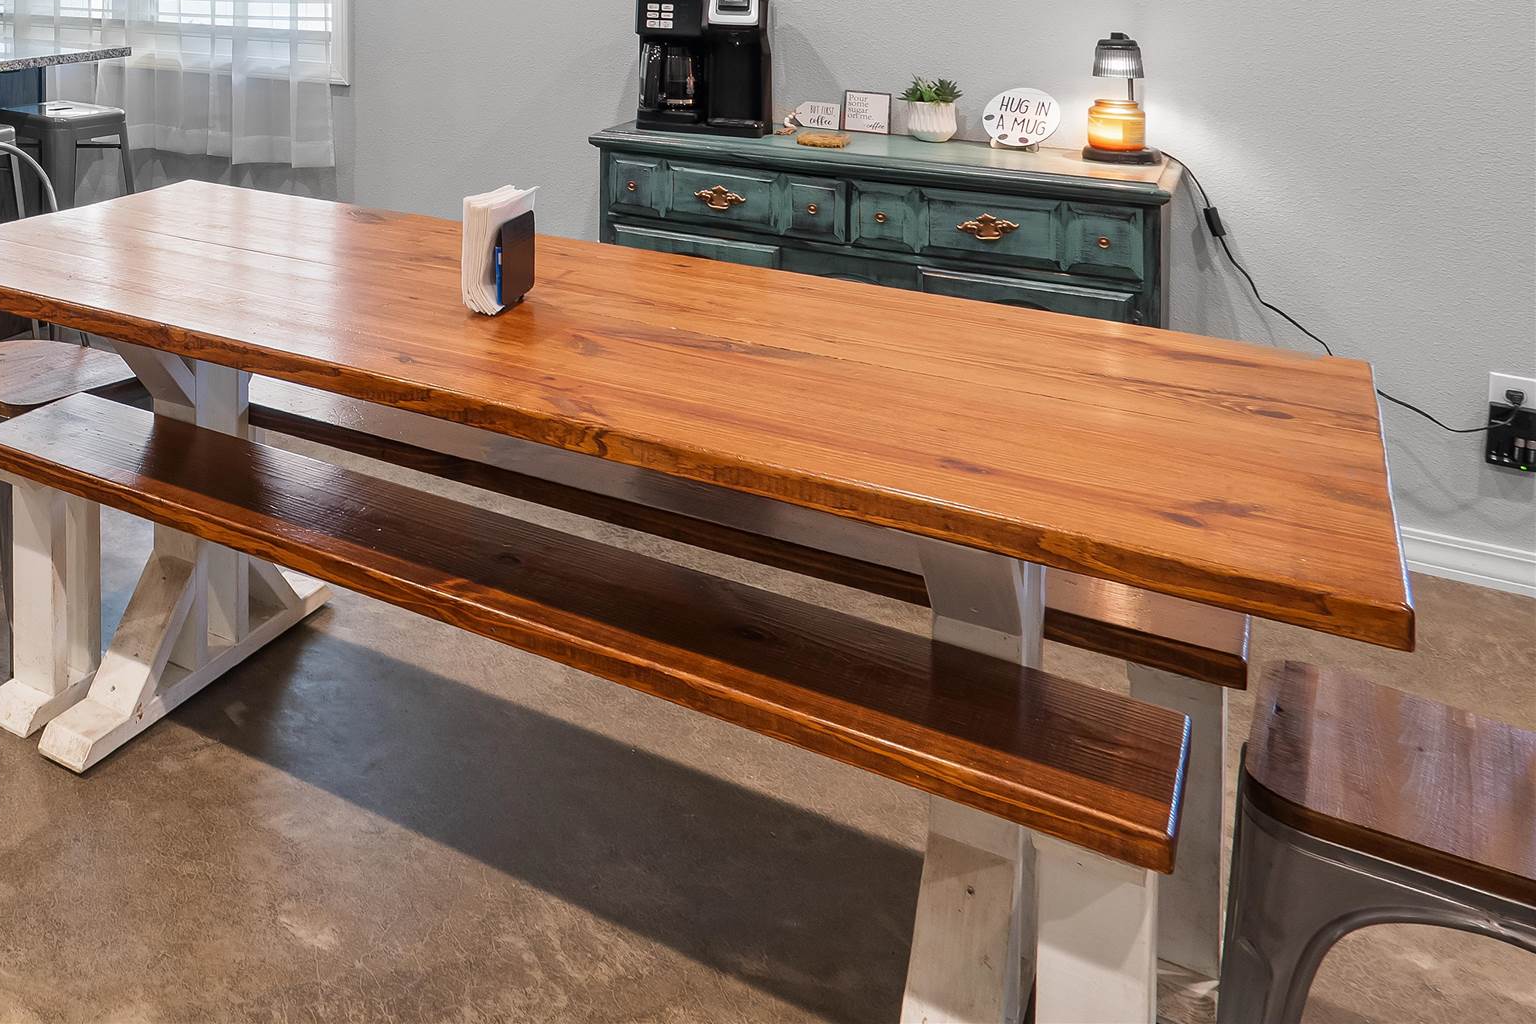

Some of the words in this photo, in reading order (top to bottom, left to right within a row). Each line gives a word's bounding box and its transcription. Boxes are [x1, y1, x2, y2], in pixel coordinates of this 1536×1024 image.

[848, 93, 869, 102] Pour
[999, 95, 1031, 114] HUG
[1035, 101, 1052, 117] IN
[809, 115, 833, 127] coffee
[996, 113, 1005, 131] A
[1011, 116, 1047, 136] MUG
